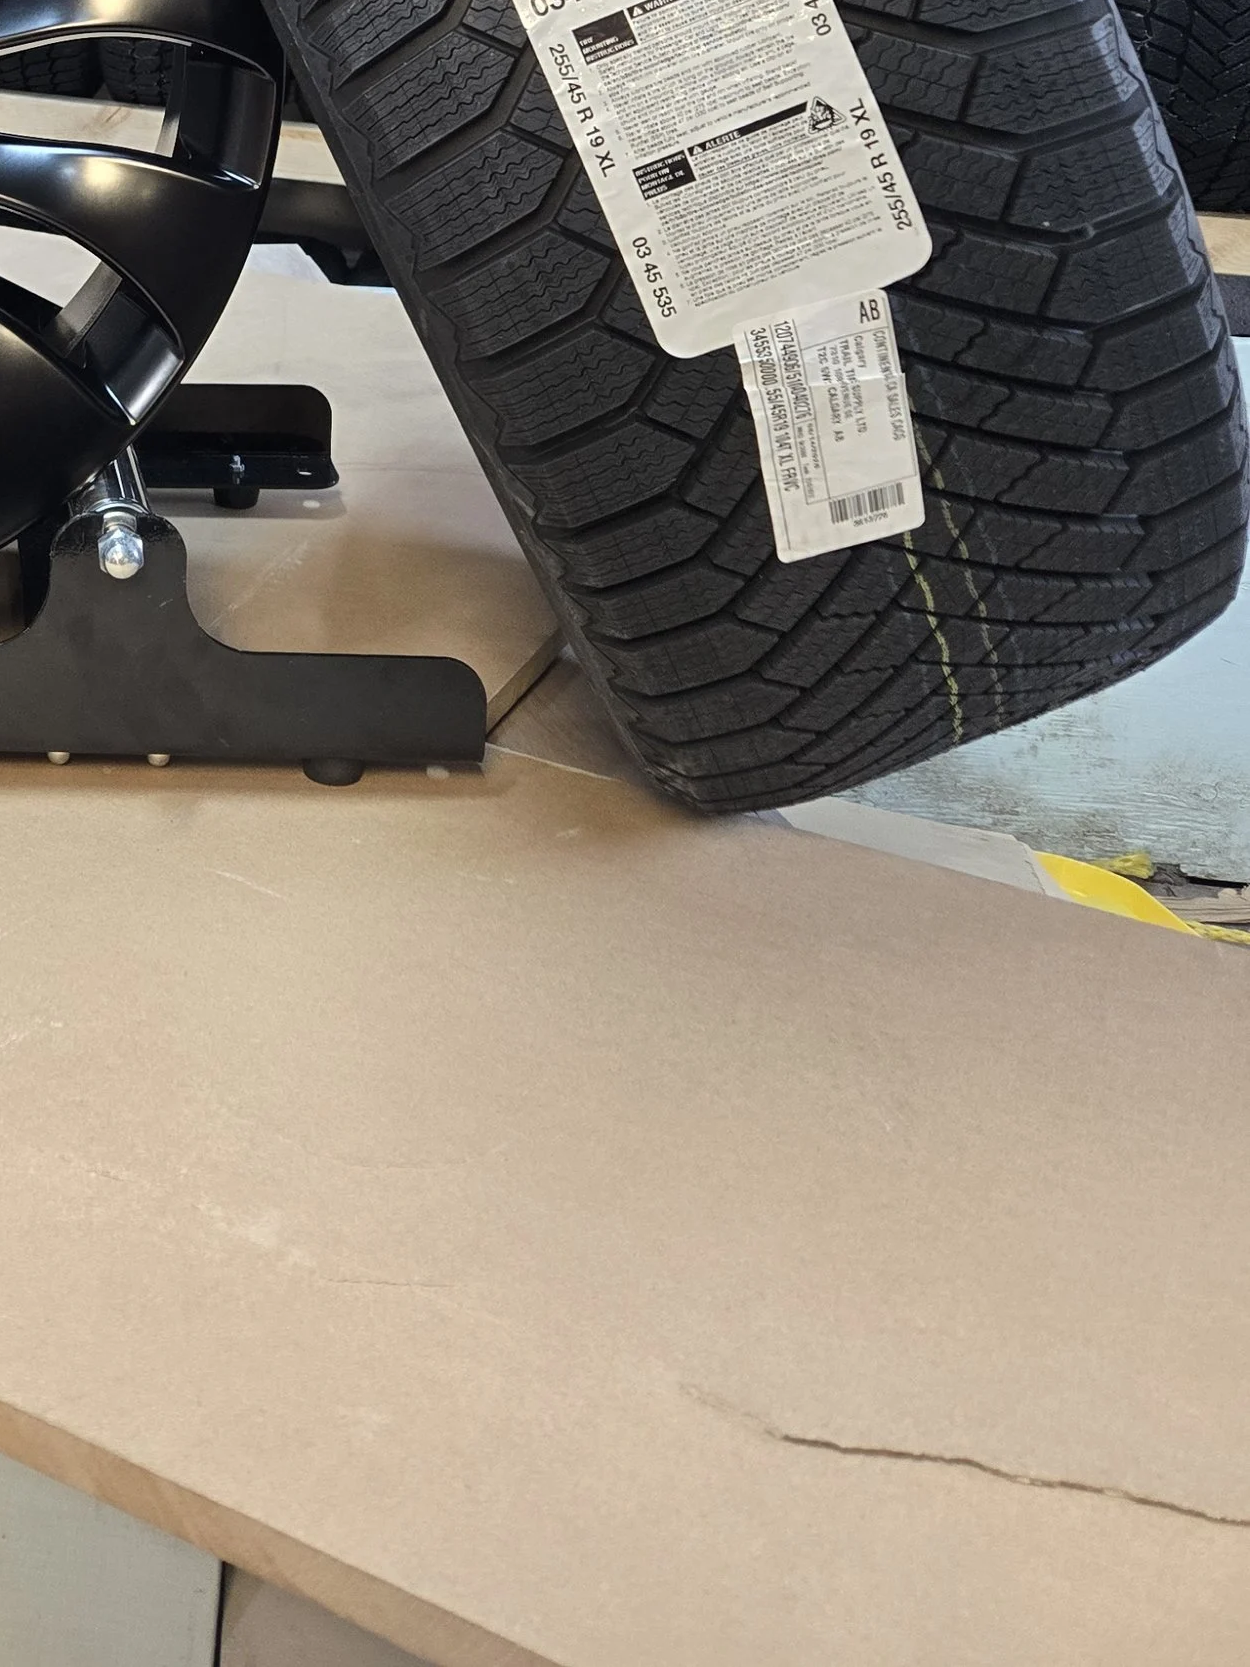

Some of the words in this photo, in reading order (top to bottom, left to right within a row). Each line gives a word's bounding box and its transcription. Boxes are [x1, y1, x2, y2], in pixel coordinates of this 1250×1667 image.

[811, 13, 833, 37] 03
[582, 35, 619, 55] MOUNTING
[585, 39, 636, 63] INSTRUCTIONS
[548, 42, 588, 105] 255/45
[576, 106, 595, 124] R
[848, 97, 870, 126] XL
[585, 126, 606, 148] 19
[703, 129, 742, 151] ALERTE
[859, 128, 881, 150] 19
[595, 150, 617, 178] XL
[634, 153, 686, 177] INSTRUCTIONS
[870, 153, 889, 169] R
[876, 172, 912, 232] 255/45
[632, 236, 652, 259] 03
[643, 262, 664, 284] 45
[652, 286, 678, 319] 535
[859, 298, 881, 324] AB
[853, 335, 867, 369] Calgary
[816, 346, 829, 366] T2C
[827, 386, 843, 425] CALGARY
[839, 339, 853, 367] TRAIL
[851, 384, 865, 415] SUPPLY
[886, 393, 902, 419] SALES
[777, 454, 795, 467] XL
